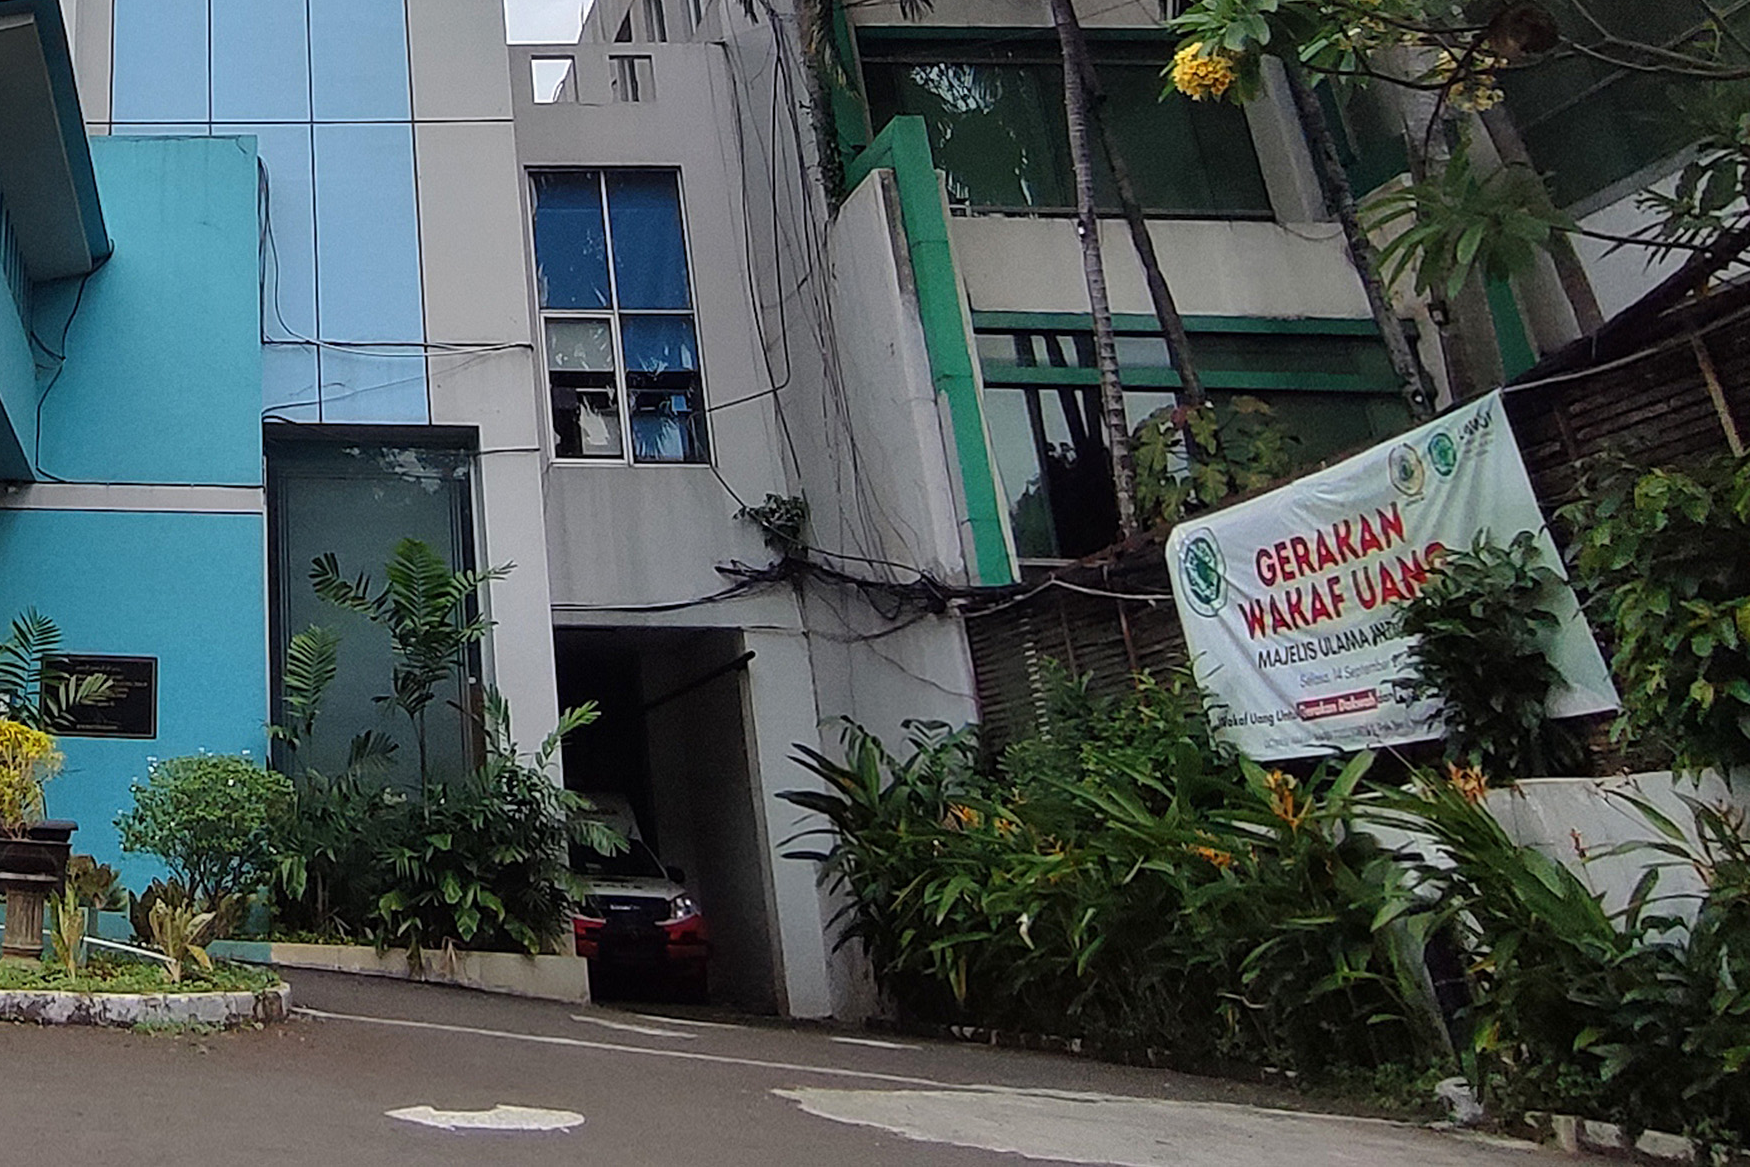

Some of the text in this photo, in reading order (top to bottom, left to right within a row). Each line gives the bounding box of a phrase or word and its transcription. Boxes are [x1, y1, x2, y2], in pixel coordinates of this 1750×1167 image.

[1255, 501, 1406, 587] GERAKAN
[1237, 576, 1345, 640] WAKAF
[1258, 641, 1319, 669] MAJELIS
[1318, 629, 1373, 657] ULAMA
[1249, 713, 1275, 727] Uang
